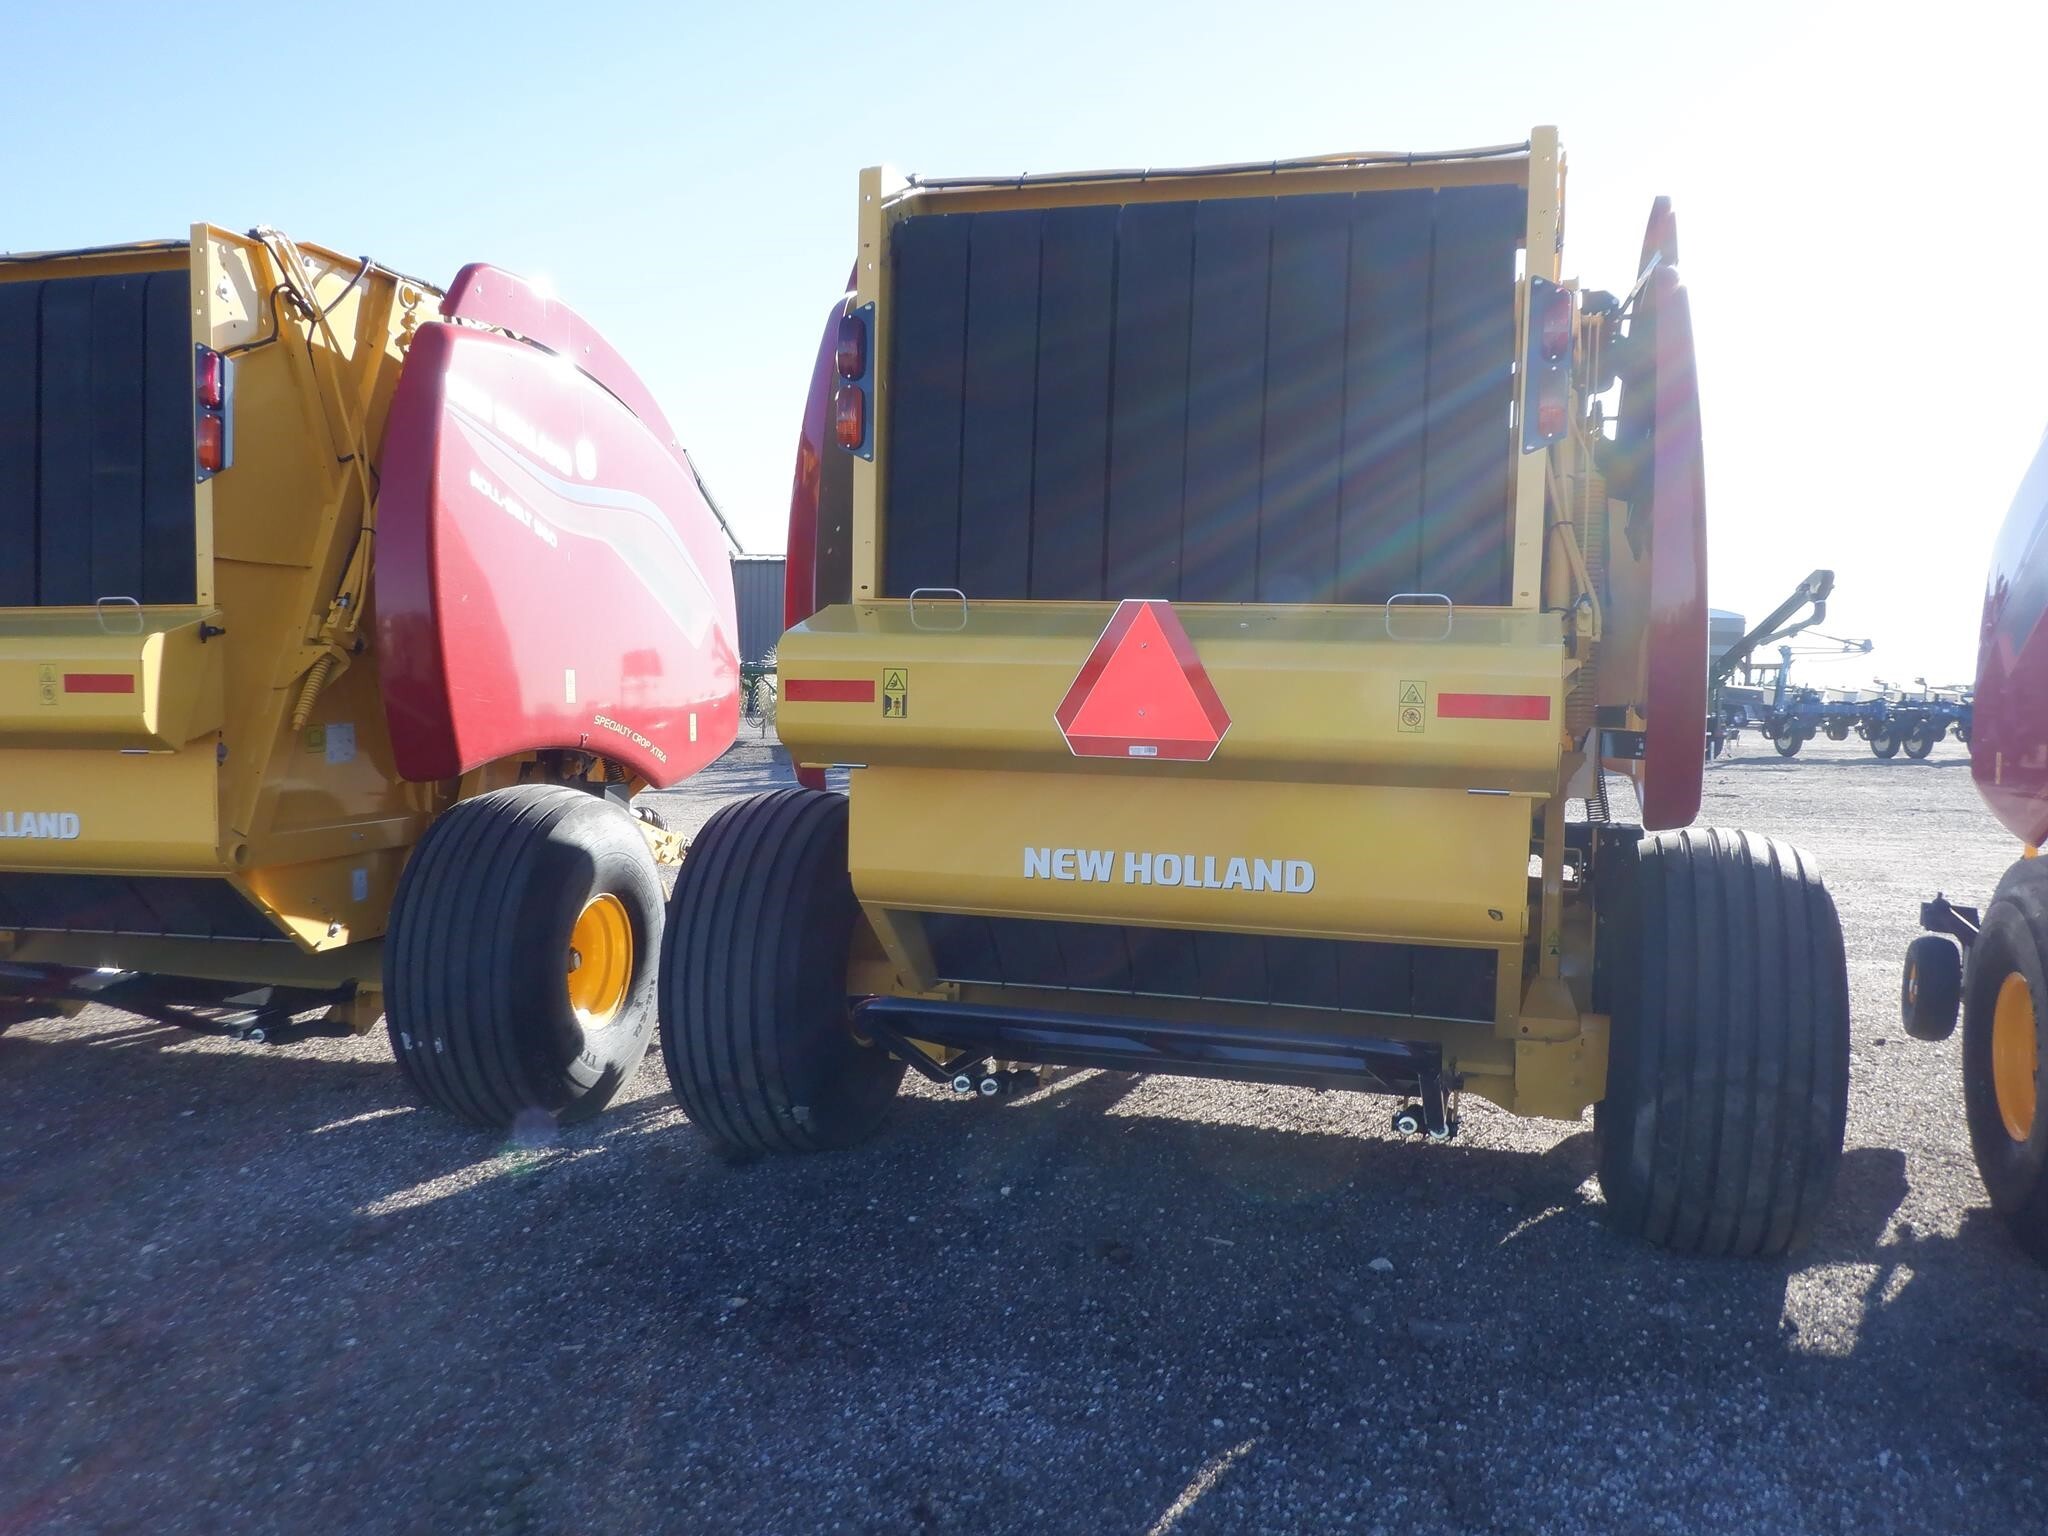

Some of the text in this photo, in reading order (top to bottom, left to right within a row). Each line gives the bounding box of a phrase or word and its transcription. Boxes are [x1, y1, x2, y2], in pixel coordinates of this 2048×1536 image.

[593, 714, 668, 763] SPECIALTY CROP XTRA
[1023, 847, 1316, 894] NEW HOLLAND
